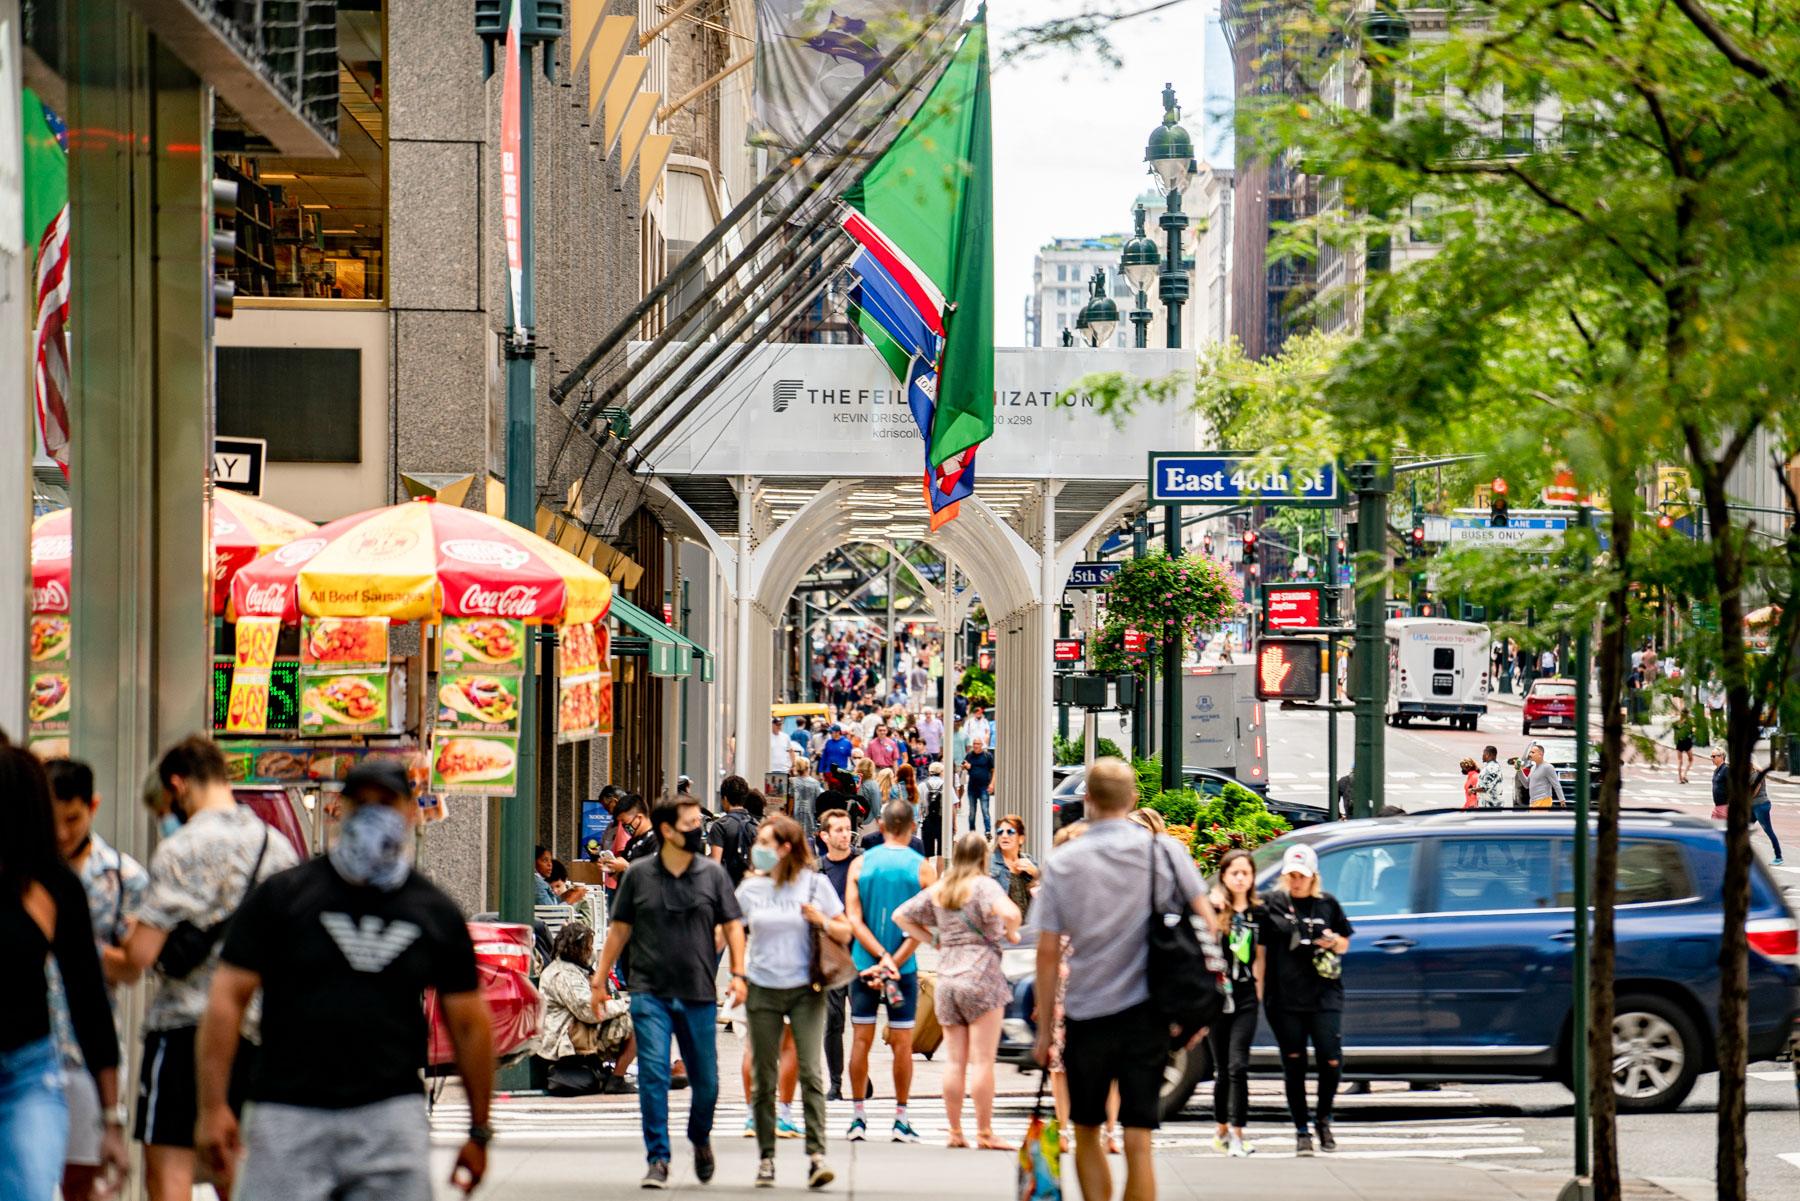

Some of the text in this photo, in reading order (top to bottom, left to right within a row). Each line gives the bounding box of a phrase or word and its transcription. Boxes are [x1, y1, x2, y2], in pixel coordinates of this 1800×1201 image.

[807, 389, 1095, 408] THE FEIL IZATION
[833, 413, 868, 423] KEVIN
[1007, 415, 1033, 425] x298
[1165, 467, 1325, 491] East 46th St
[1508, 519, 1531, 528] LANE
[1461, 530, 1525, 540] BUSES ONLY
[1068, 569, 1097, 583] 45th
[310, 589, 425, 606] All Beef Sausages
[1281, 592, 1311, 600] STANDING
